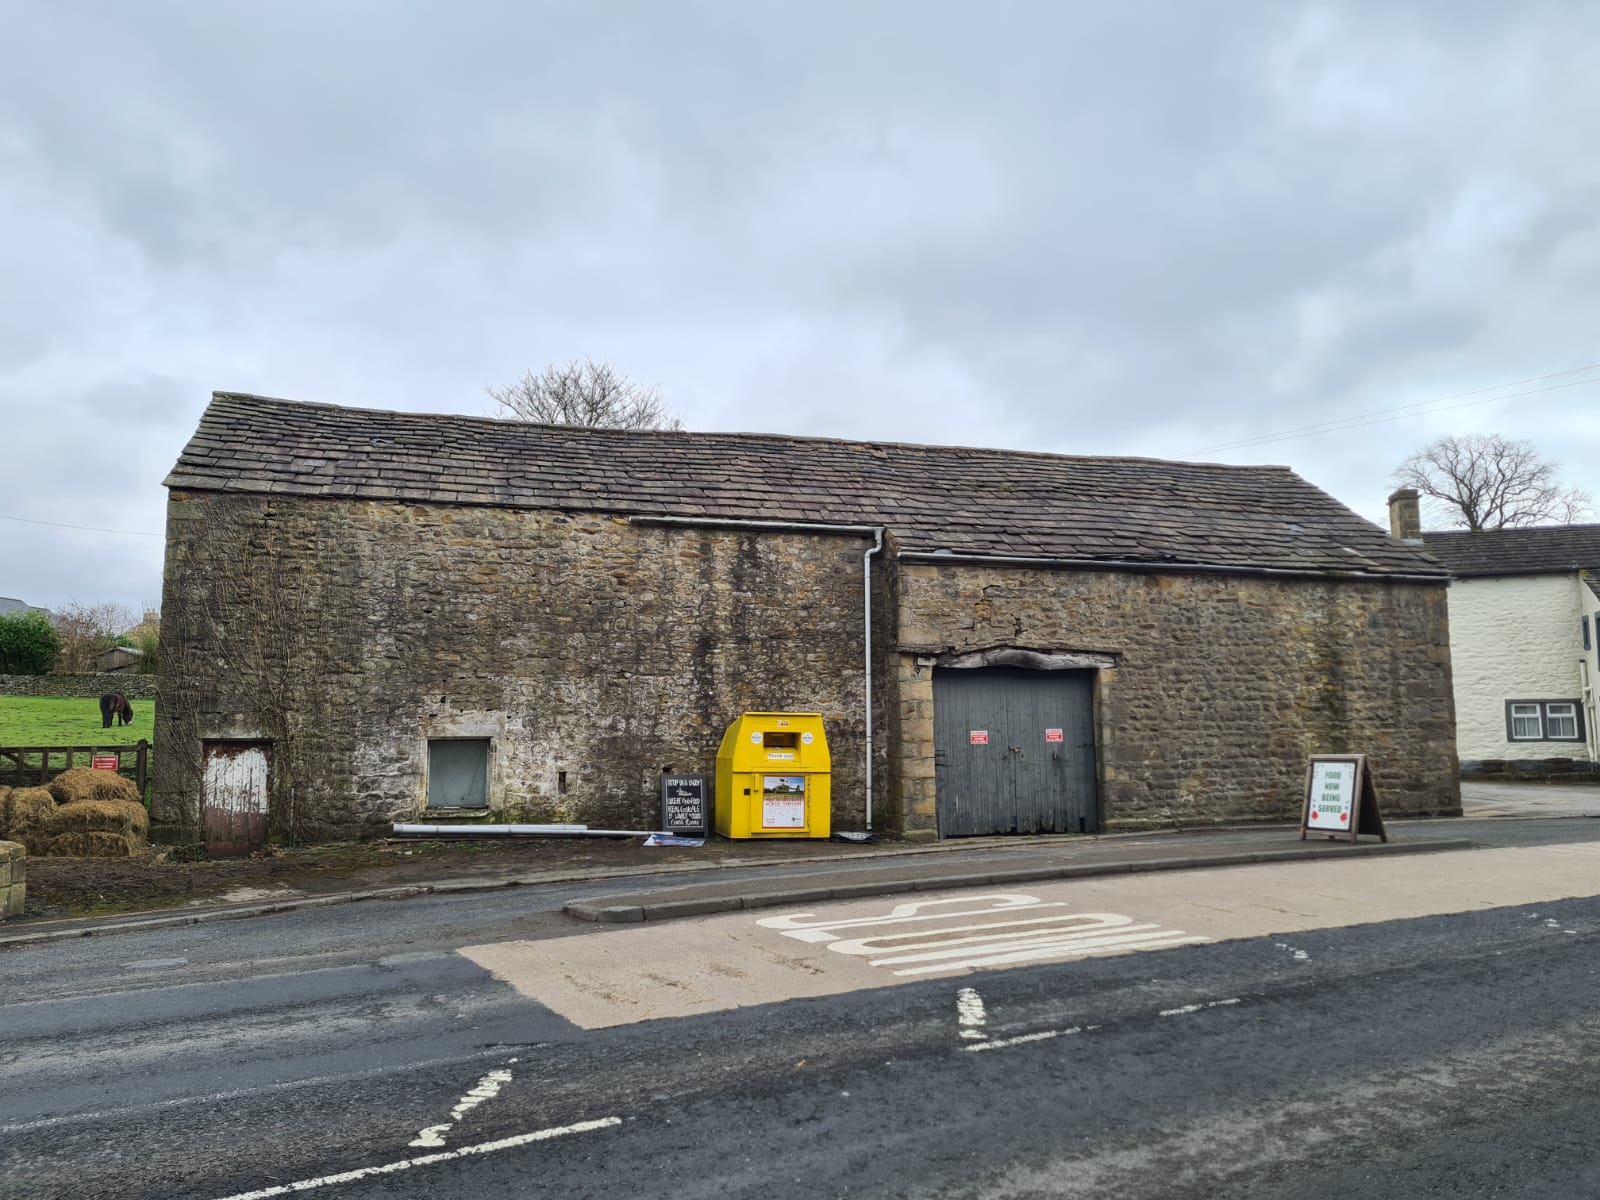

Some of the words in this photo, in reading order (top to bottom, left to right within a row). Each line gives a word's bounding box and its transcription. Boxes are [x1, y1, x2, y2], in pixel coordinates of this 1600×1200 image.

[1325, 771, 1342, 779] FOOD
[1321, 793, 1341, 802] BEING
[1318, 804, 1342, 813] SERVED
[755, 893, 1211, 977] SLOW
